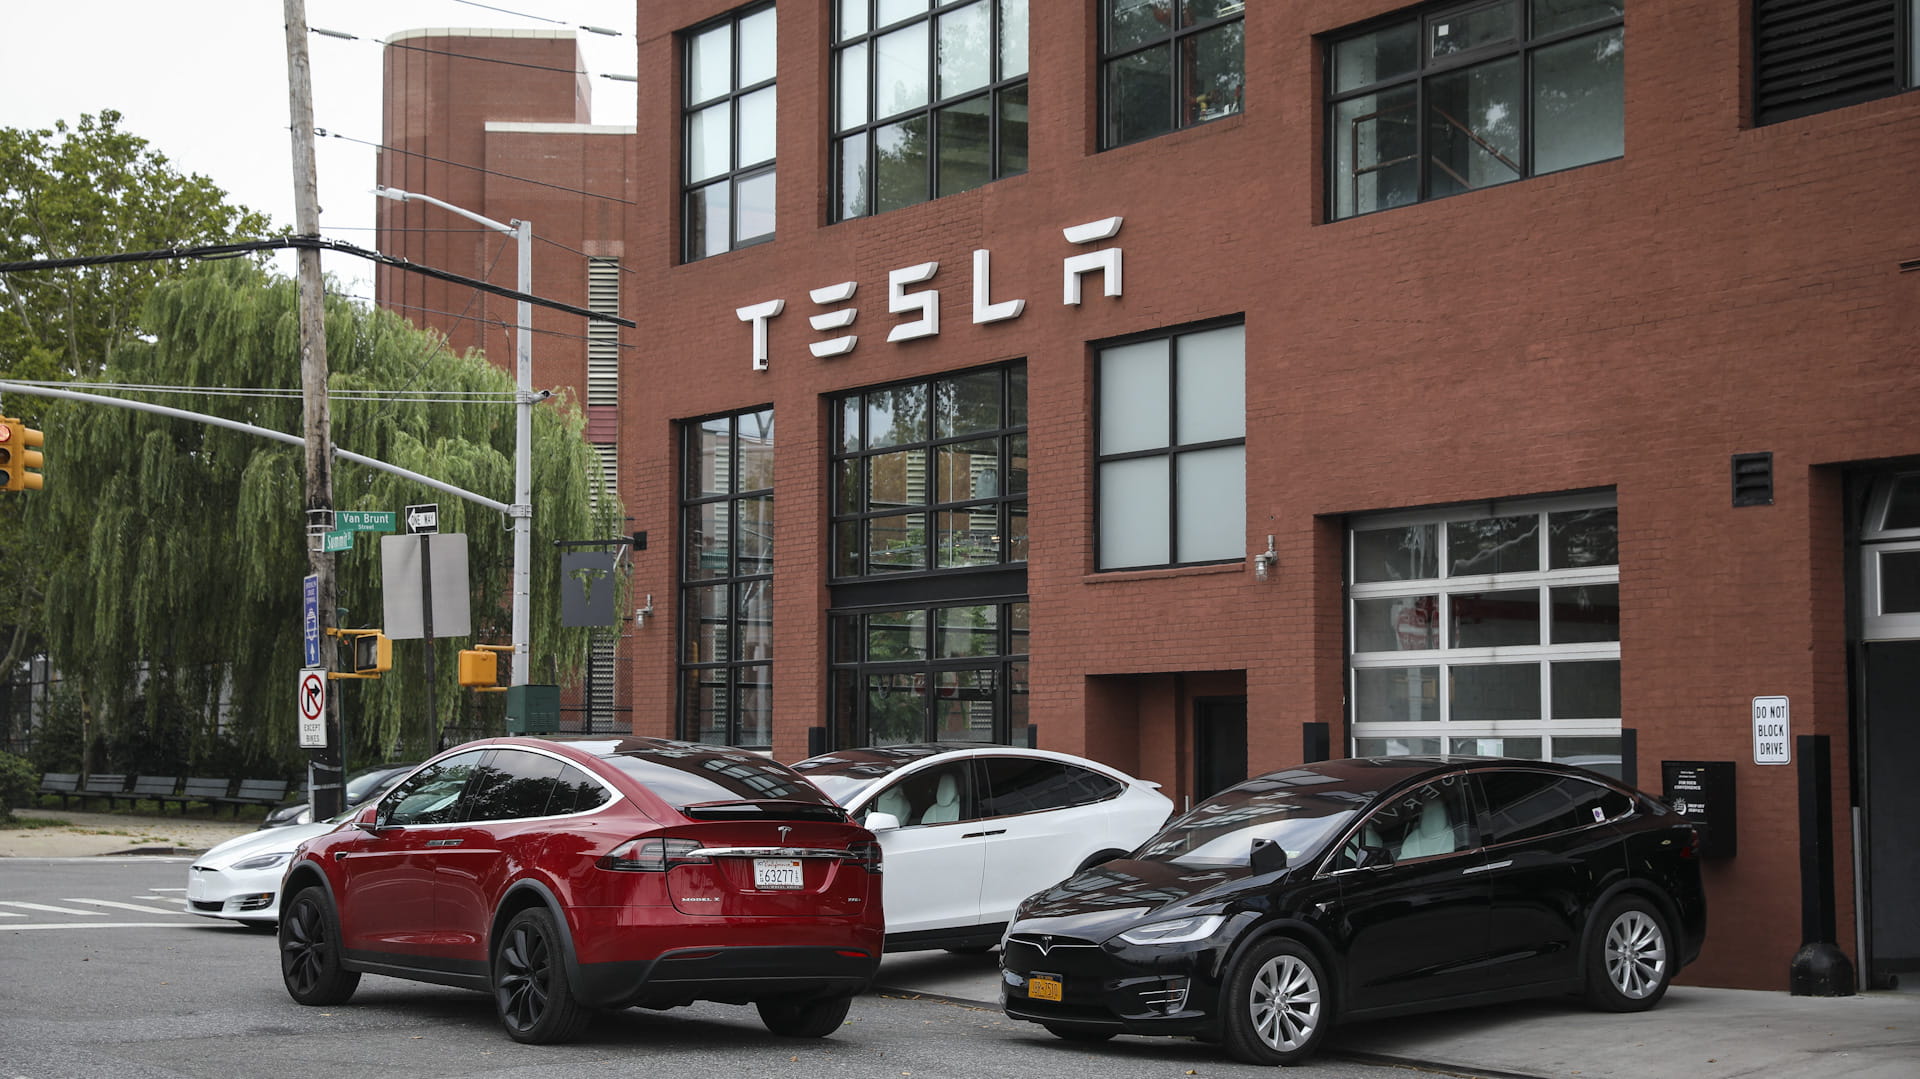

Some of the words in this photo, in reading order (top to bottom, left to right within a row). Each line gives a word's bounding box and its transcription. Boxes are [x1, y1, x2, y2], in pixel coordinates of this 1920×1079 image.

[735, 216, 1123, 371] TESLA
[343, 513, 360, 523] Van
[363, 513, 389, 523] Brunt
[411, 513, 421, 526] ONE
[424, 512, 435, 525] WAY
[327, 532, 348, 550] Summit
[1756, 706, 1767, 719] DO
[1770, 706, 1785, 719] NOT
[1758, 724, 1784, 737] BLOCK
[1760, 742, 1784, 755] DRIVE
[765, 869, 793, 883] 63277
